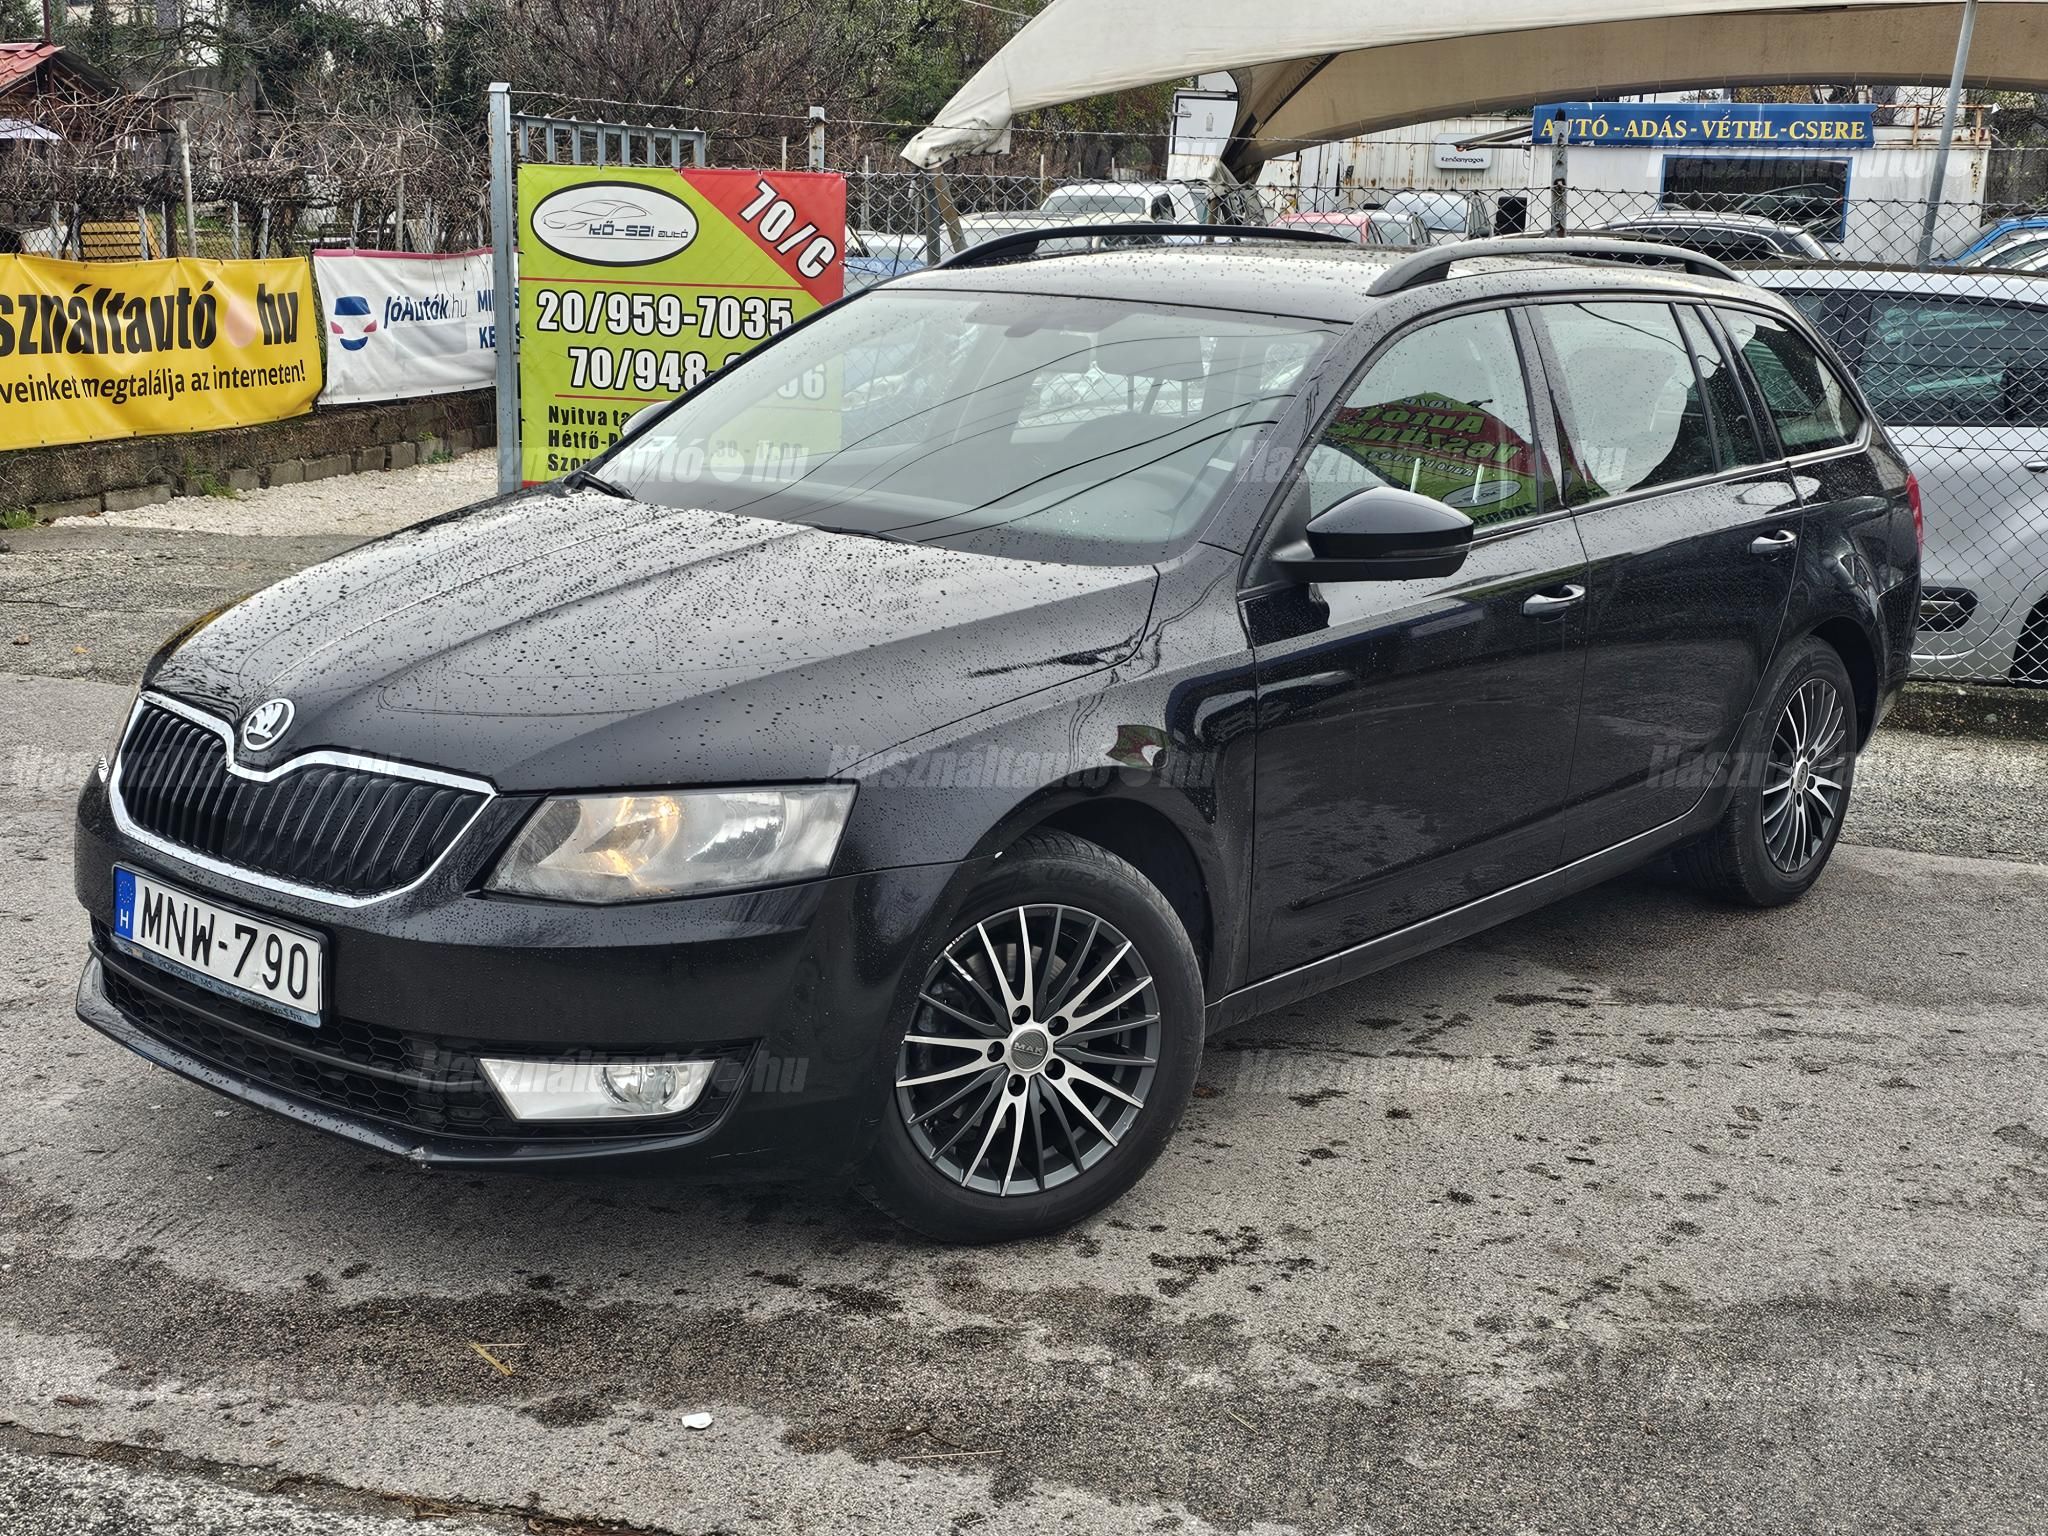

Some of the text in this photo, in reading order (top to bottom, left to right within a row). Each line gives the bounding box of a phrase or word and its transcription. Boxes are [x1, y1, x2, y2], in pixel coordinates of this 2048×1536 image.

[1625, 117, 1687, 140] ADÁS
[1703, 115, 1779, 140] VÉTEL
[1789, 120, 1865, 141] CSERE
[738, 178, 837, 279] 70/C
[537, 289, 793, 340] 20/959-7035
[81, 368, 185, 405] megtalálja
[191, 370, 209, 391] az
[213, 359, 306, 390] interneten!
[548, 405, 608, 426] Nyitva
[119, 886, 309, 1001] H MNW-790
[1013, 1041, 1043, 1056] MAK
